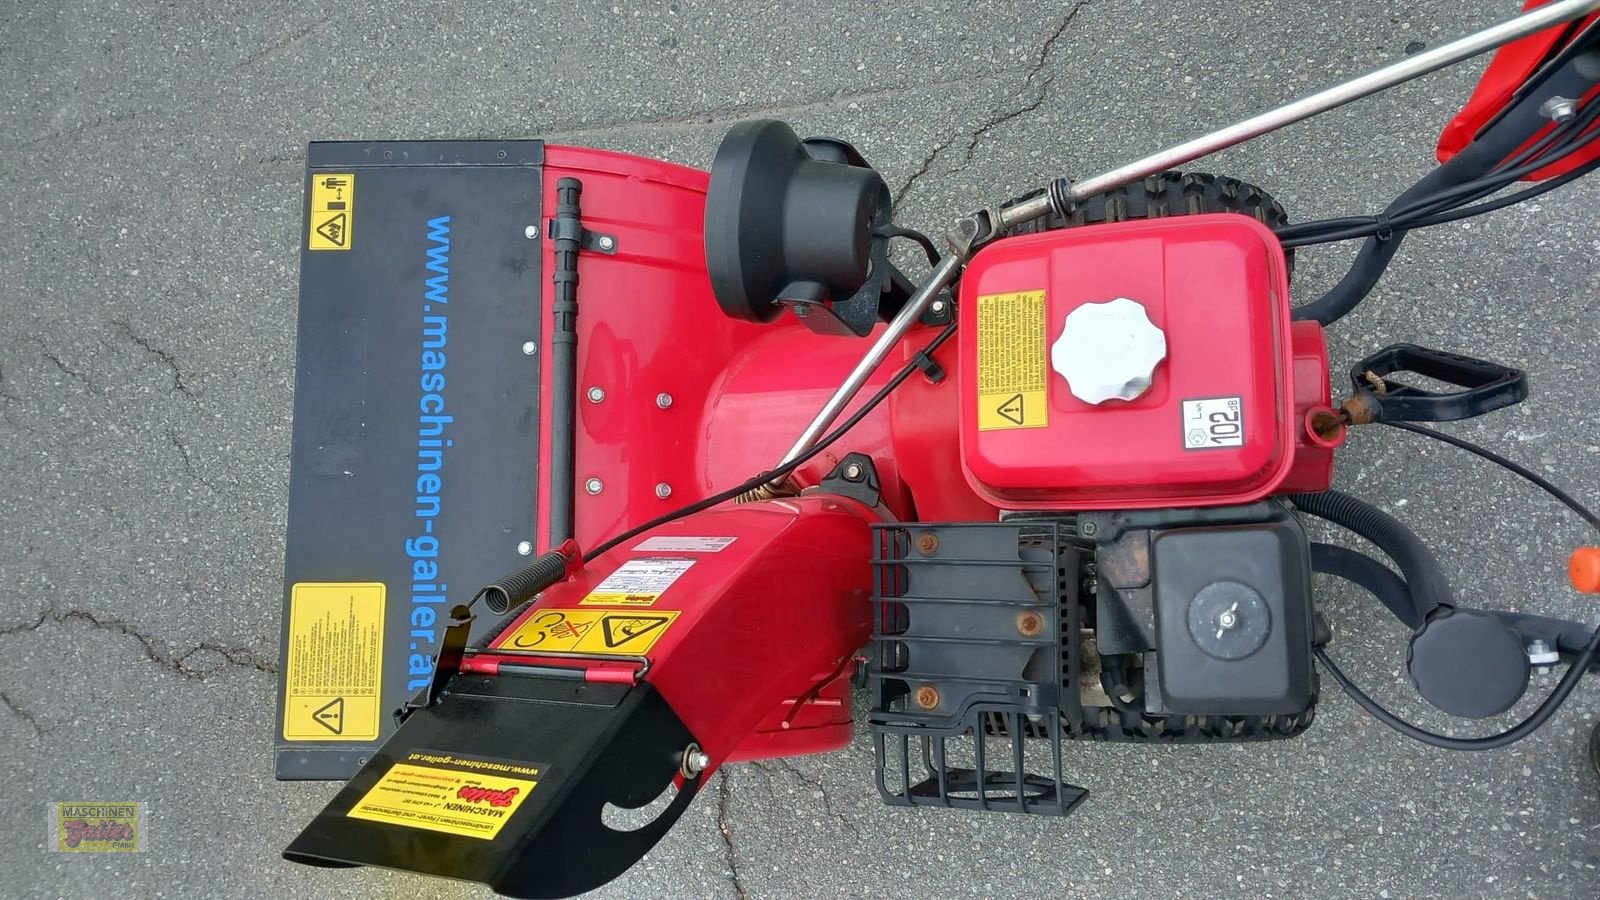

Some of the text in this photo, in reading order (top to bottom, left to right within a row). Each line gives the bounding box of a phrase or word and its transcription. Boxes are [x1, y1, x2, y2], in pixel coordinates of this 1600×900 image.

[408, 753, 539, 776] www.maschinen-gailer.at
[443, 802, 505, 817] MASCHINEN
[440, 817, 494, 831] Landmaschinen
